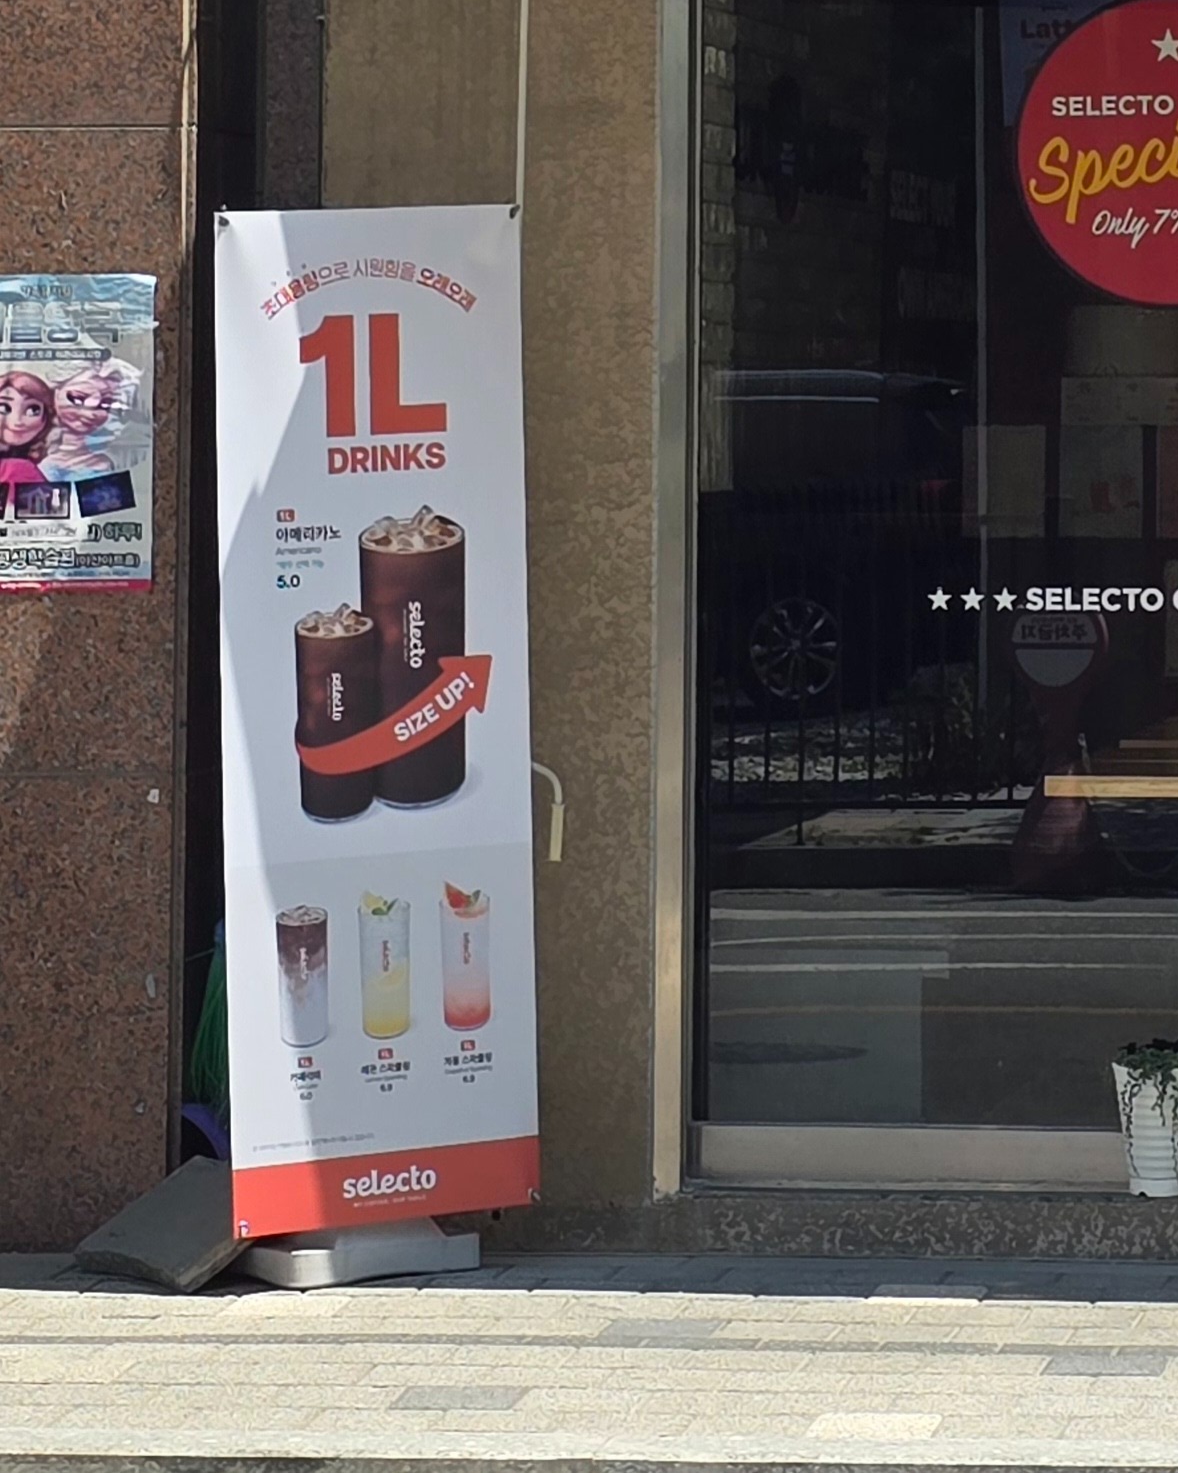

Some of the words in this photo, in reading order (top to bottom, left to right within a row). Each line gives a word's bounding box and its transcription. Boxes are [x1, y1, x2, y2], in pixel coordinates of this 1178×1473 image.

[1052, 94, 1174, 117] SELECTO
[1092, 208, 1149, 249] Only
[299, 313, 447, 438] 1L
[328, 442, 446, 475] DRINKS
[1026, 587, 1164, 612] SELECTO
[408, 601, 426, 669] selecto
[394, 703, 440, 741] SIZE
[434, 671, 475, 711] UP!
[343, 1165, 436, 1199] selecto
